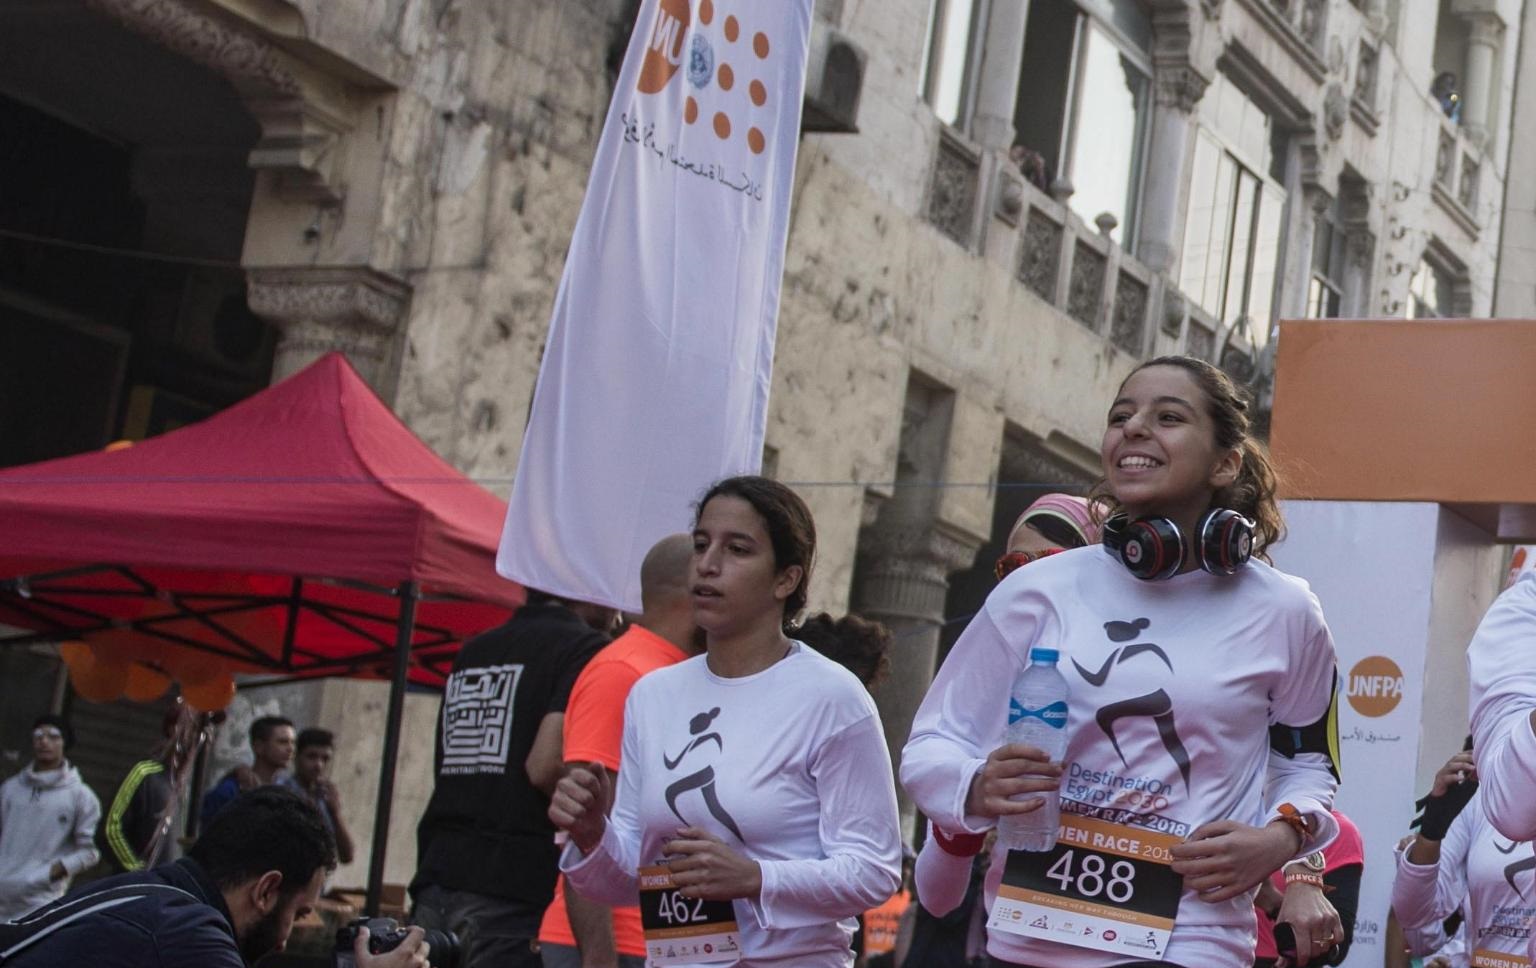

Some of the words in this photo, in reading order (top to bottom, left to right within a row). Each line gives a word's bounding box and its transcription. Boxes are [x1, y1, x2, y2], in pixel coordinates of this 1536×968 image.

[1347, 675, 1404, 698] UNFPA
[1066, 779, 1114, 803] Egypt
[1069, 762, 1172, 796] DestinatiOn
[1147, 815, 1188, 837] 2018
[1092, 831, 1140, 855] RACE
[1142, 845, 1175, 862] 201
[1045, 849, 1136, 903] 488
[658, 891, 708, 924] 462
